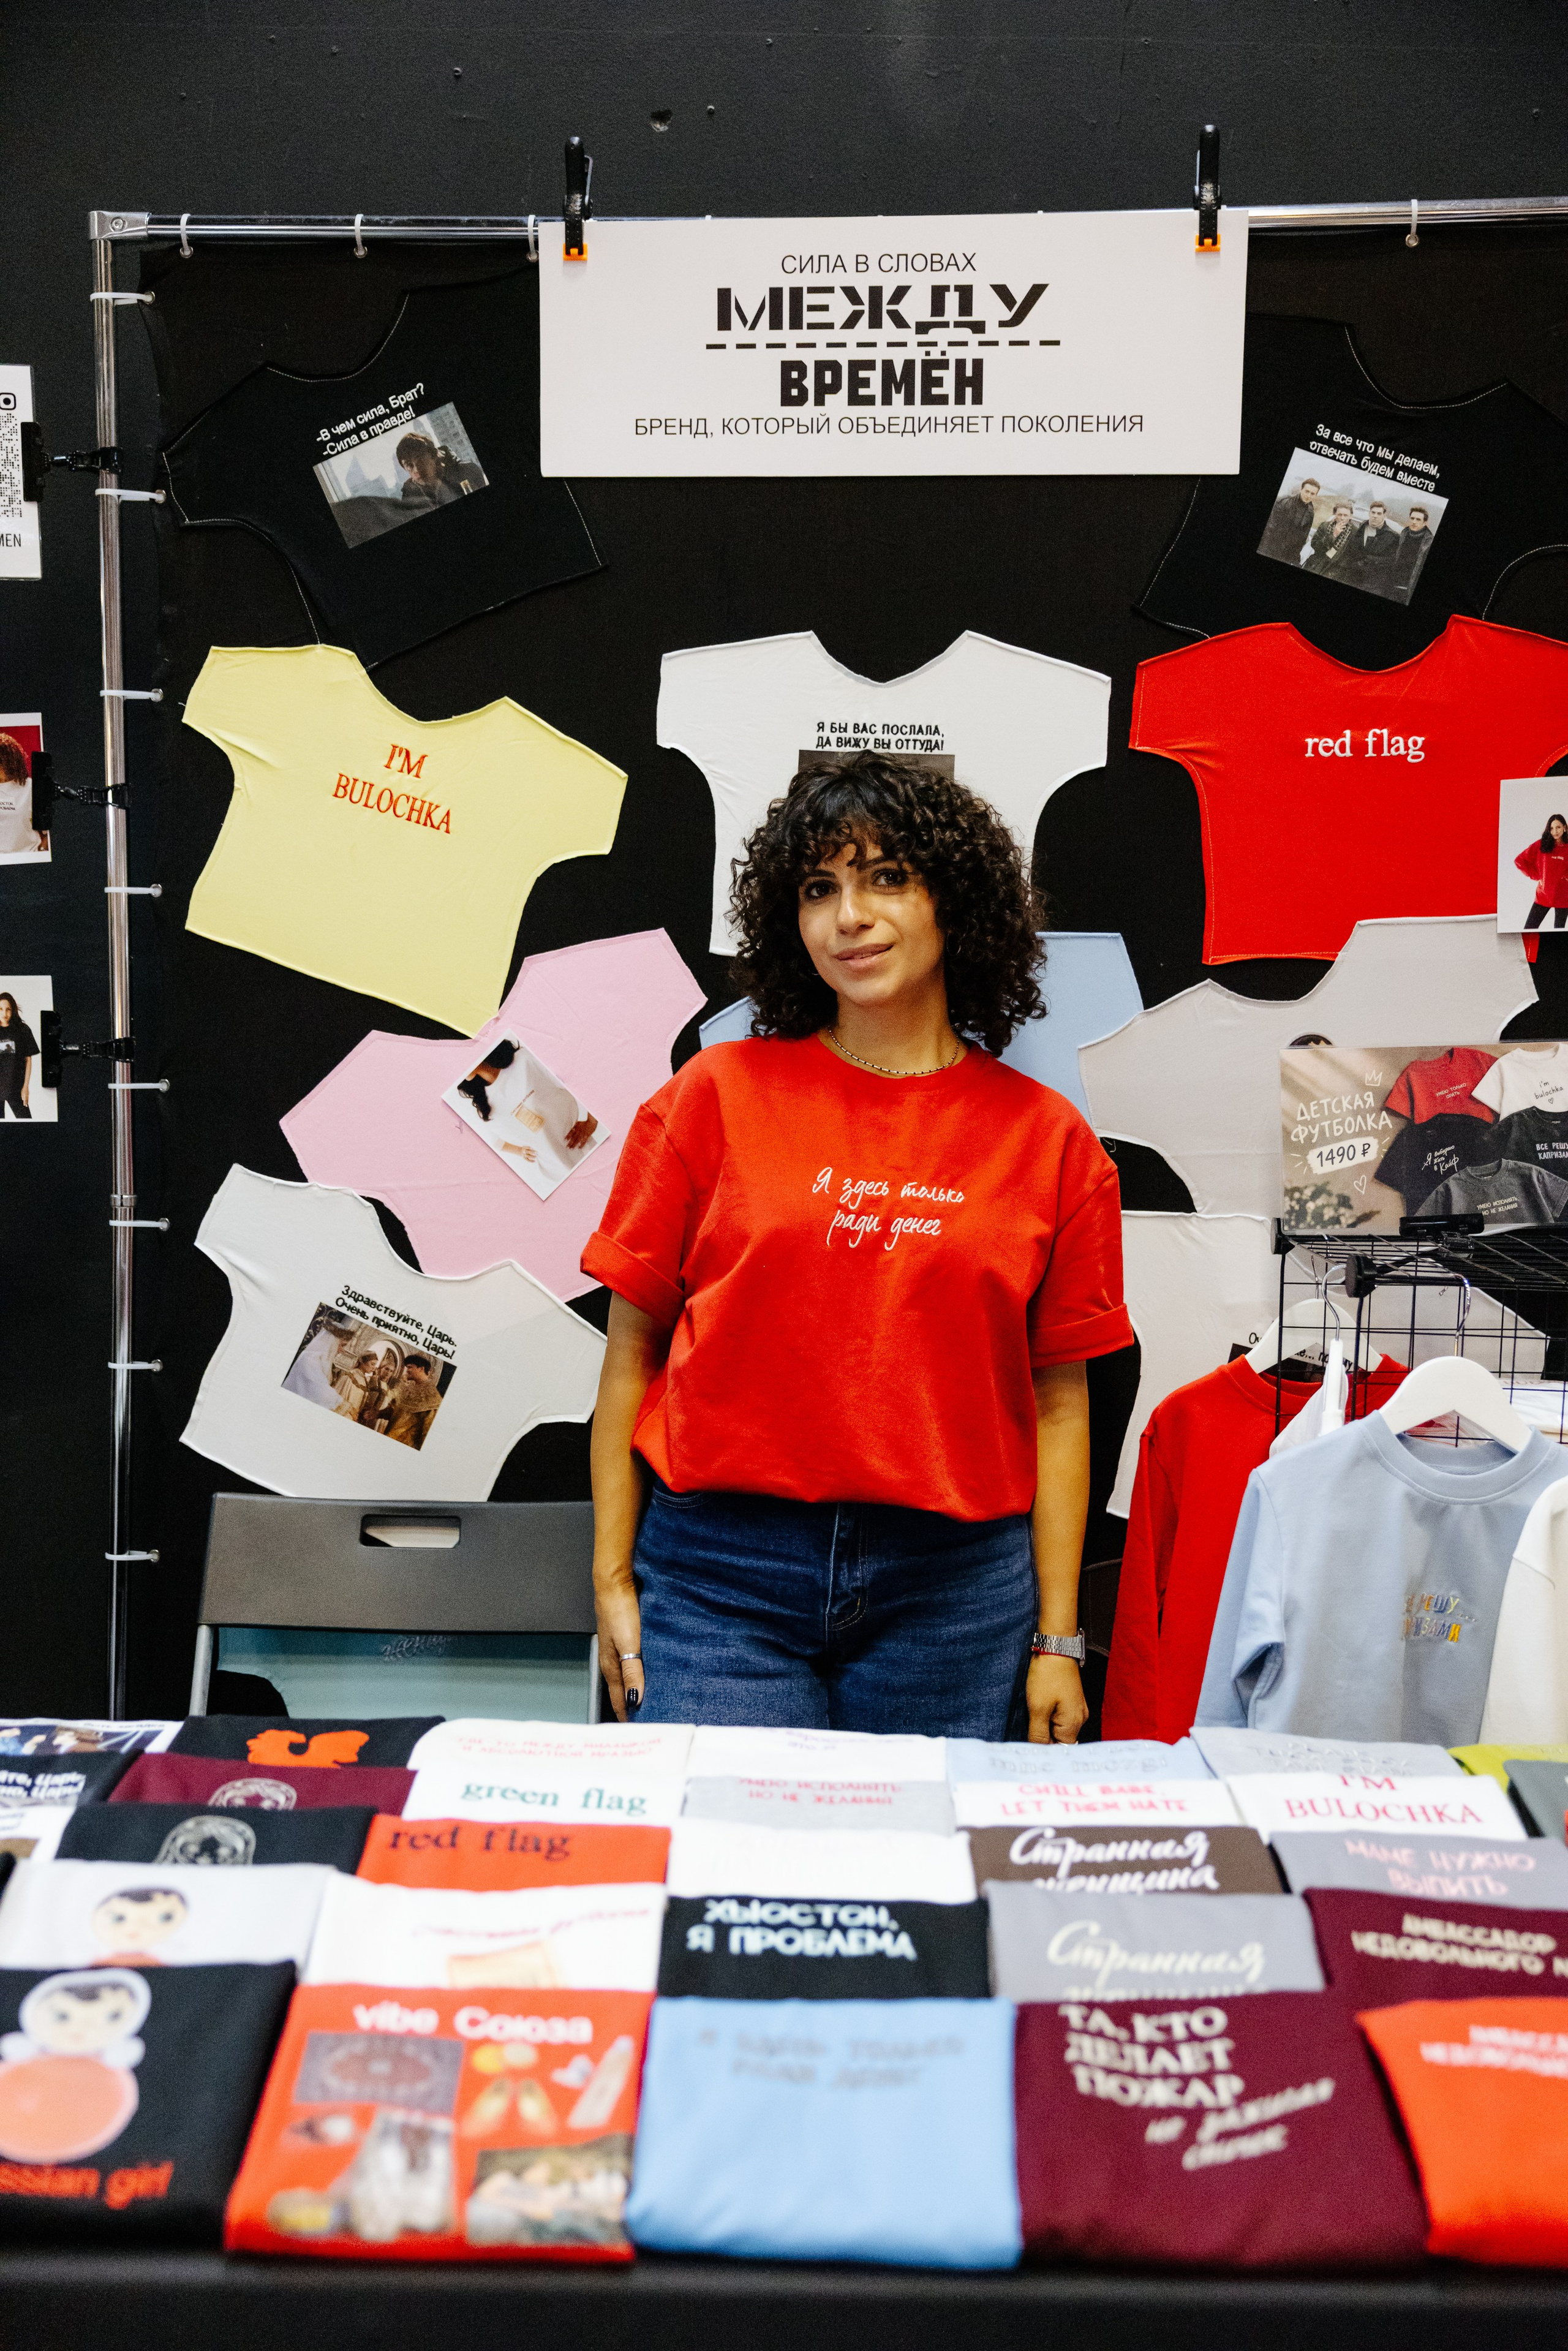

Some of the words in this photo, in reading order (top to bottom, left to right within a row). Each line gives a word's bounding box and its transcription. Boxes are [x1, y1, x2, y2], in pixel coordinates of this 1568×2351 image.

[781, 254, 846, 274] СИЛА
[856, 254, 870, 273] В
[876, 252, 976, 273] СЛОВАХ
[717, 284, 1049, 334] МЕЖДУ
[780, 350, 984, 407] ВРЕМЁН
[331, 420, 356, 434] чем
[356, 404, 390, 424] сила,
[388, 382, 424, 409] Брат?
[635, 417, 714, 438] БРЕНД,
[722, 412, 831, 435] КОТОРЫЙ
[838, 415, 995, 437] ОБЪЕДИНЯЕТ
[1001, 414, 1144, 434] ПОКОЛЕНИЯ
[323, 433, 360, 455] -Сила
[361, 431, 369, 440] в
[369, 406, 416, 436] правде!
[1310, 440, 1357, 466] отвечать
[1361, 456, 1393, 478] будем
[1396, 470, 1435, 492] вместе
[1316, 424, 1330, 439] За
[1333, 431, 1352, 446] все
[1355, 438, 1374, 453] что
[1377, 446, 1393, 459] мы
[1395, 453, 1440, 479] делаем,
[816, 722, 824, 733] Я
[830, 723, 848, 733] БЫ
[853, 723, 877, 734] ВАС
[882, 724, 944, 738] ПОСЛАЛА,
[816, 736, 832, 749] ДА
[836, 737, 869, 749] ВИЖУ
[874, 739, 891, 749] ВЫ
[895, 739, 944, 752] ОТТУДА!
[1305, 730, 1353, 757] red
[1365, 728, 1425, 763] flag
[383, 744, 428, 779] I'M
[332, 772, 451, 834] BULOCHKA
[1297, 1092, 1374, 1121] ДЕТСКАЯ
[1534, 1086, 1564, 1100] bulochka
[1291, 1111, 1392, 1144] ФУТБОЛКА
[1316, 1144, 1356, 1168] 1490
[812, 1167, 832, 1194] Я
[839, 1178, 889, 1210] здесь
[900, 1182, 965, 1202] только
[826, 1209, 881, 1248] ради
[884, 1217, 942, 1251] денег
[341, 1285, 424, 1333] Здравствуйте,
[335, 1297, 369, 1321] Очень
[372, 1316, 420, 1345] приятно,
[422, 1338, 456, 1360] Царь!
[461, 1781, 559, 1808] green
[581, 1787, 647, 1816] flag
[1286, 1798, 1485, 1824] BULOCHKA
[389, 1826, 461, 1851] red
[484, 1828, 570, 1862] flag
[1009, 1825, 1210, 1879] Странная
[686, 1924, 715, 1953] Я
[729, 1926, 918, 1960] ПРОБЛЕМА
[1047, 1920, 1265, 1991] Странная
[353, 2000, 440, 2034] vibe
[1132, 2006, 1228, 2043] КТО
